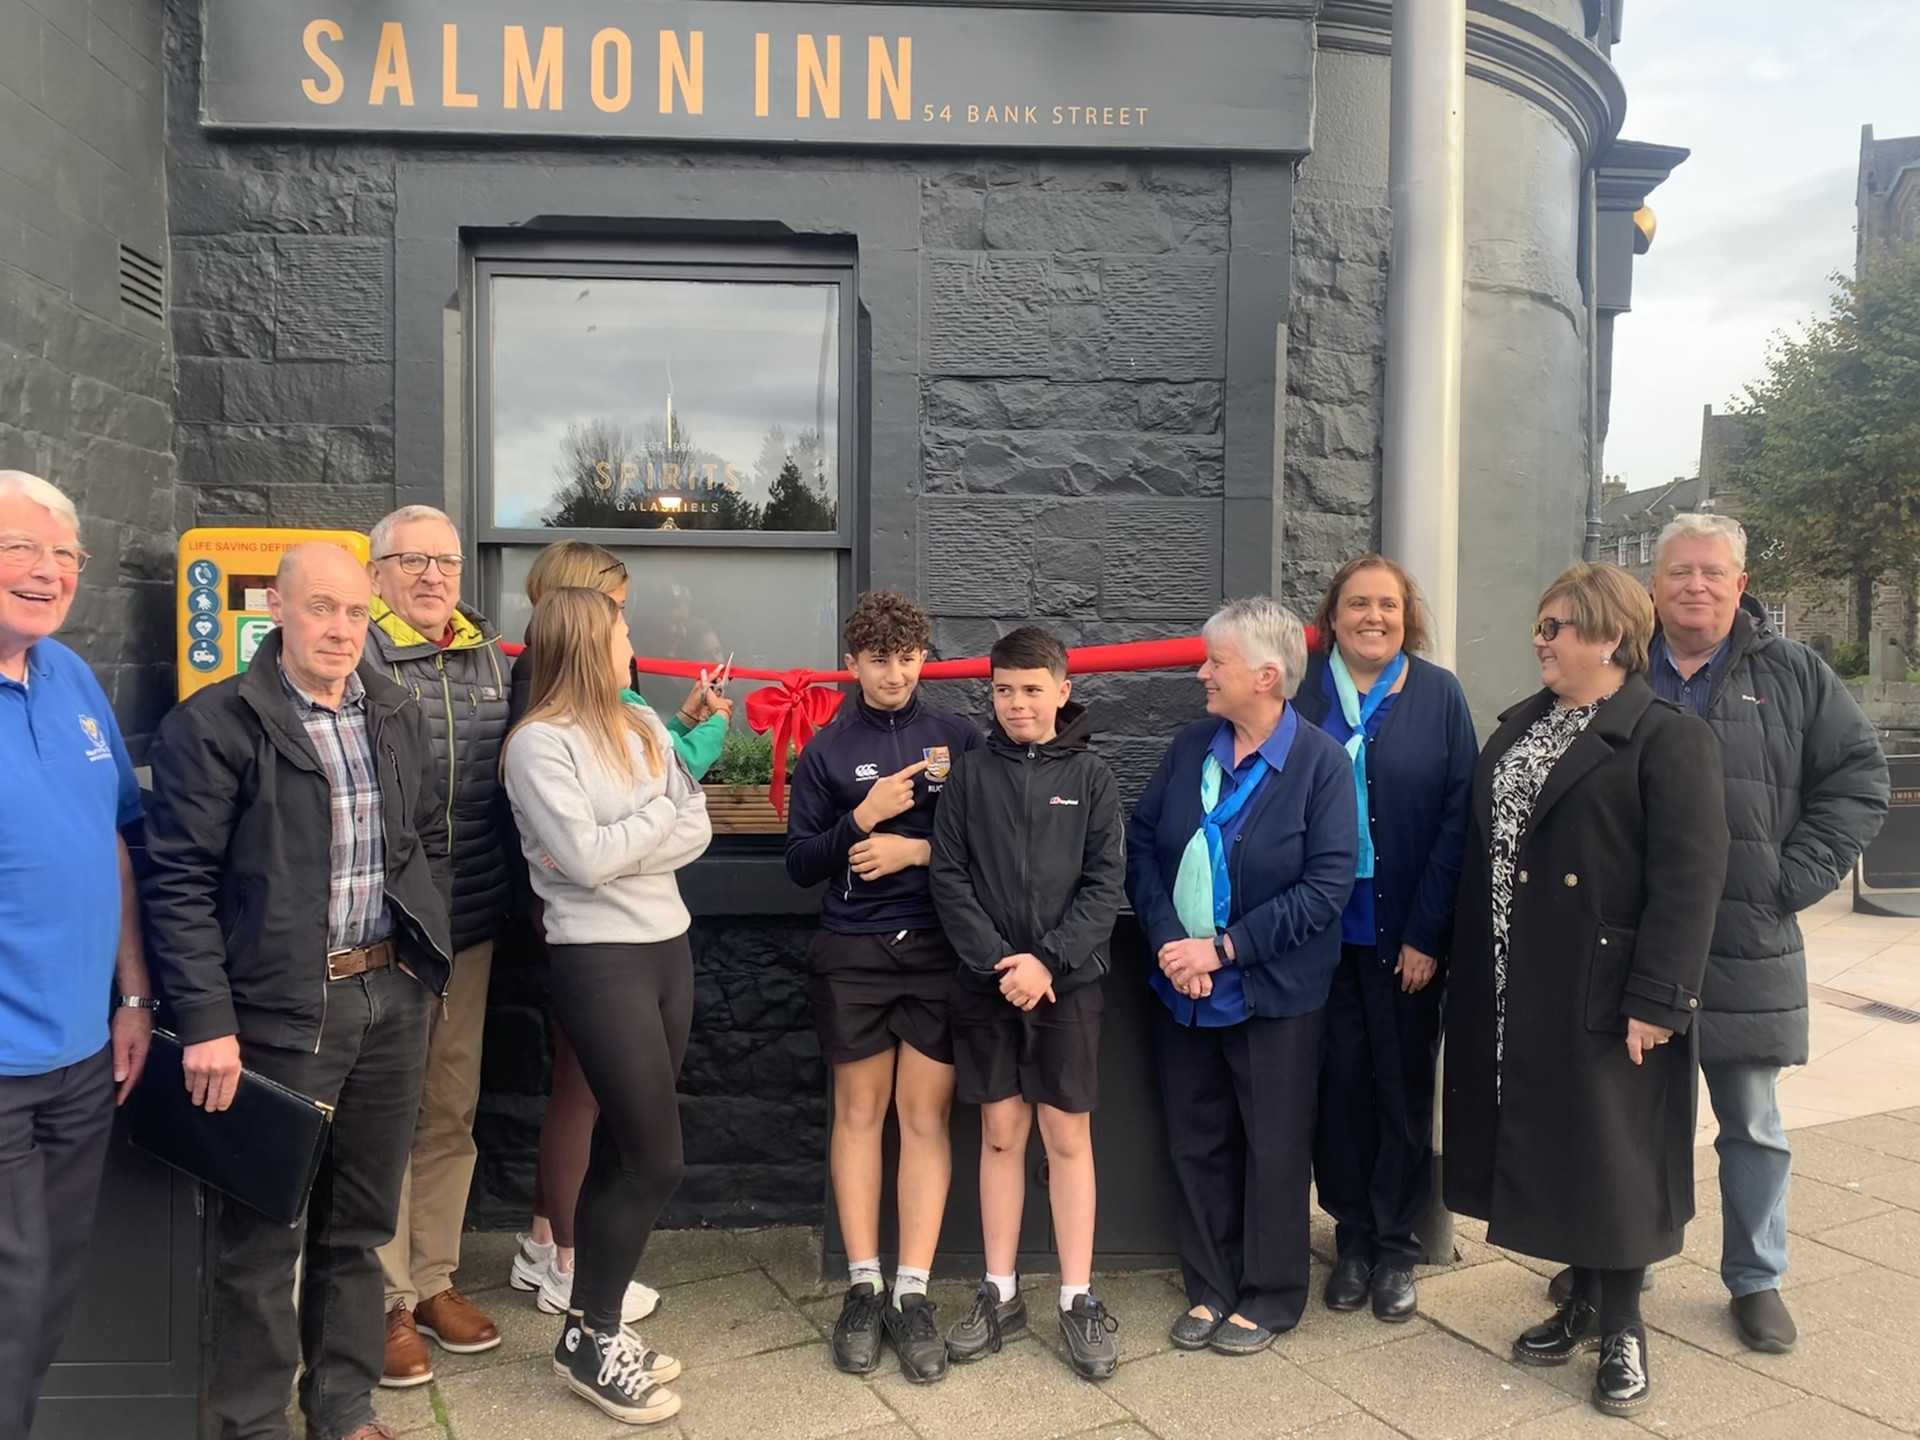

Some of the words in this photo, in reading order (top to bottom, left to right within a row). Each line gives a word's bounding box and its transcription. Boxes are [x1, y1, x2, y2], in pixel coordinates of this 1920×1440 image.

[301, 18, 704, 115] SALMON
[754, 32, 912, 121] INN
[923, 105, 953, 123] 54
[967, 105, 1038, 124] BANK
[1052, 106, 1149, 126] STREET
[640, 441, 665, 453] EST.
[595, 461, 741, 491] SPIRITS
[616, 501, 719, 513] GALASHIELS
[188, 541, 213, 551] LIFE
[215, 541, 258, 552] SAVING
